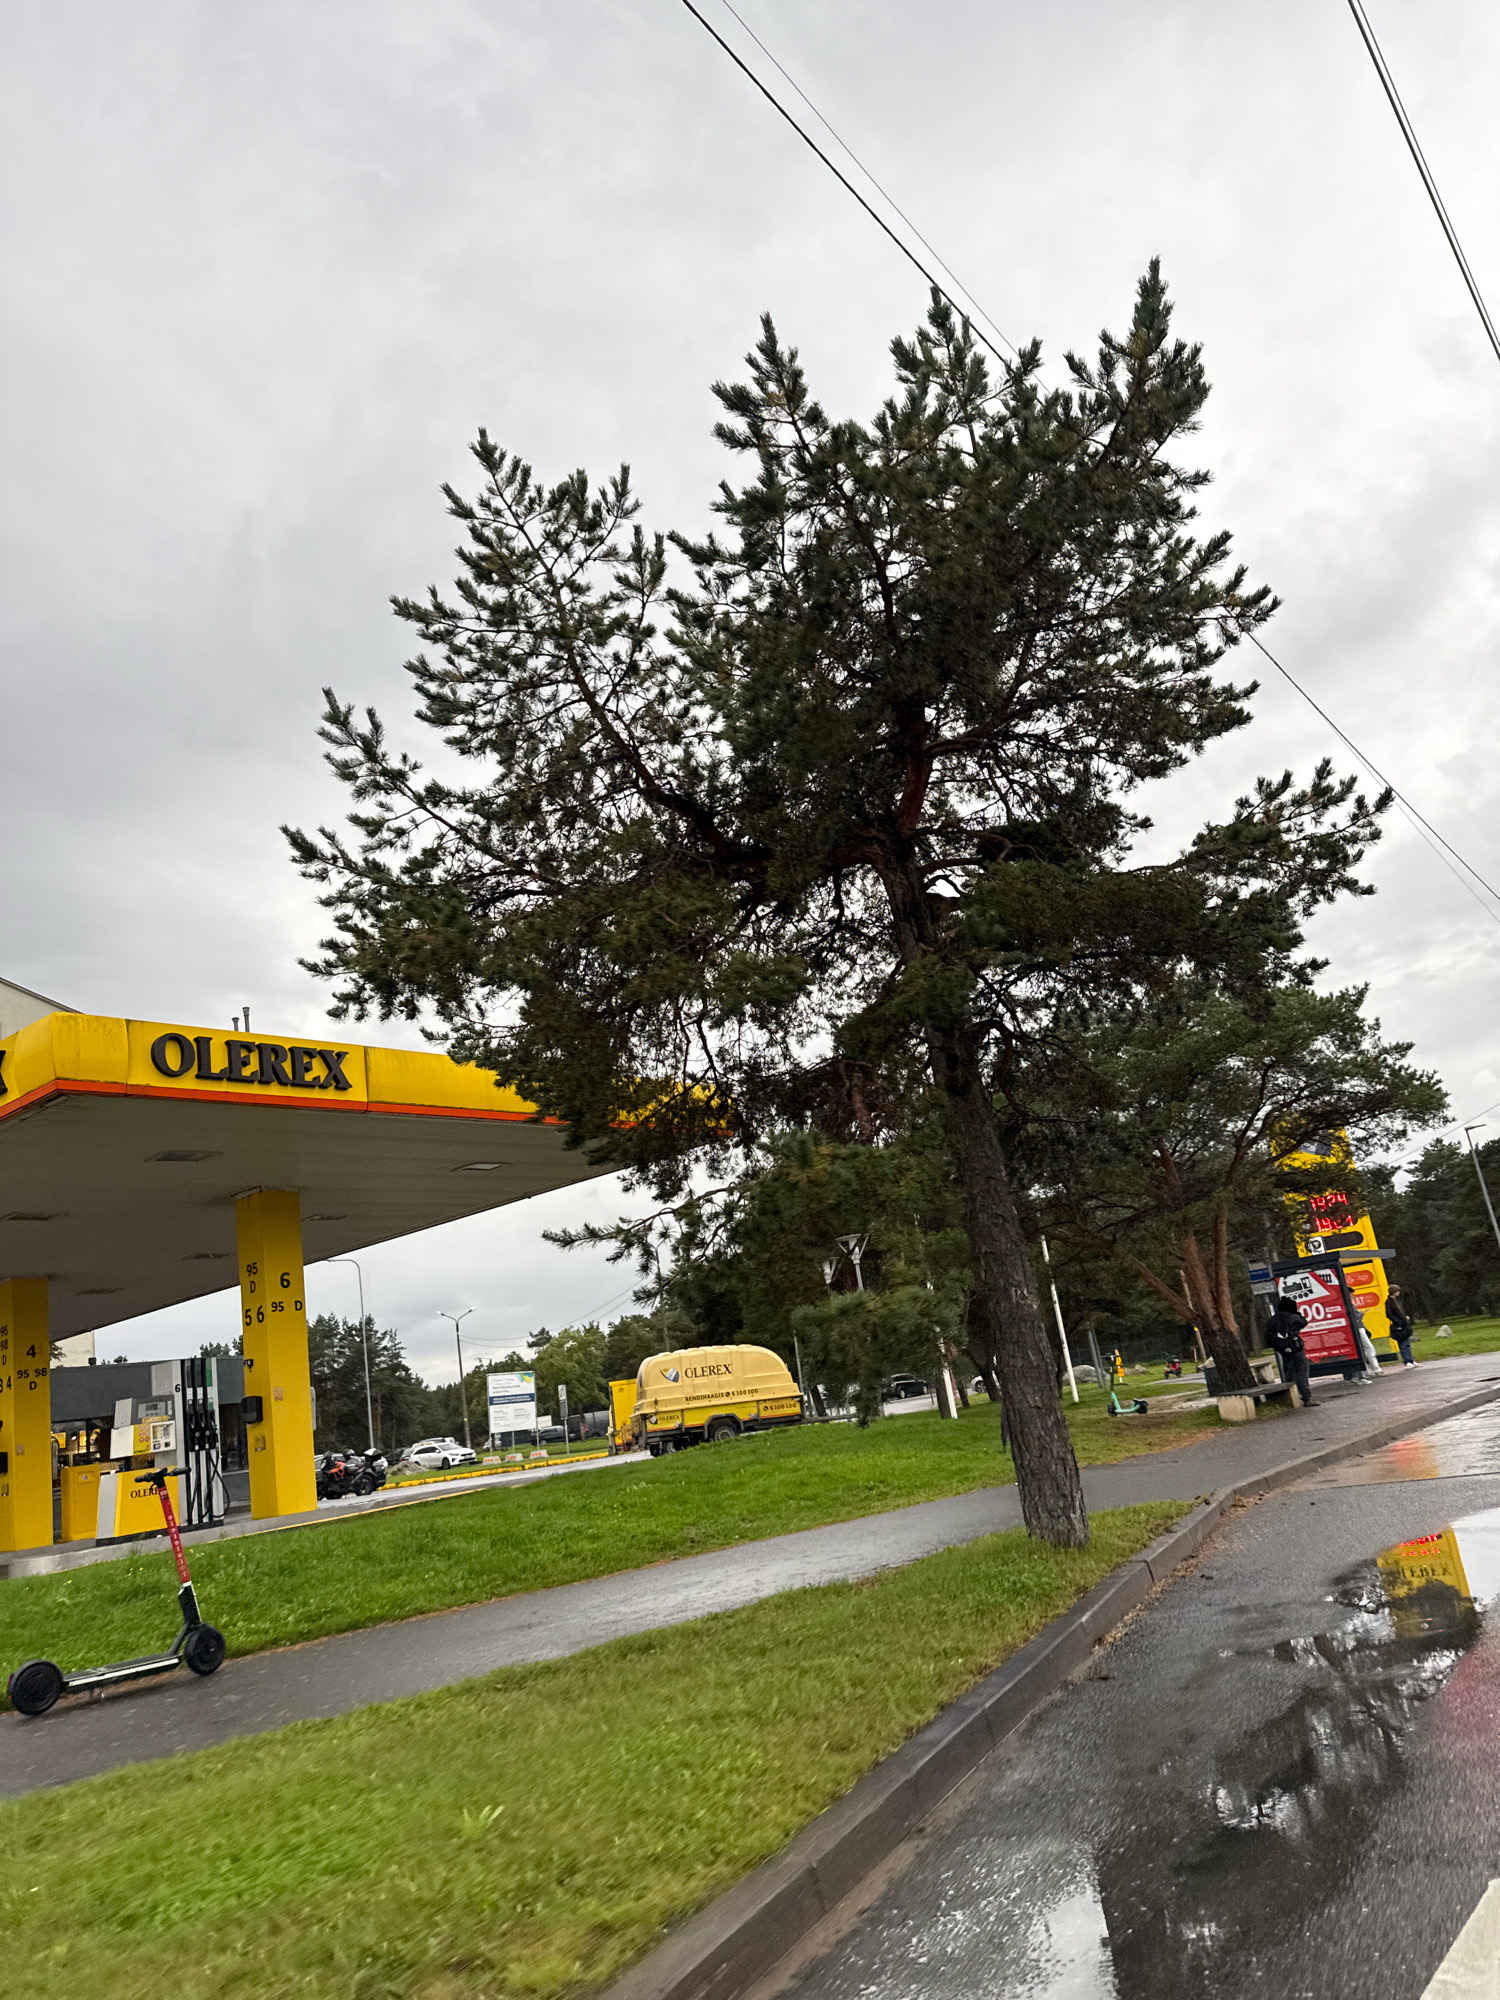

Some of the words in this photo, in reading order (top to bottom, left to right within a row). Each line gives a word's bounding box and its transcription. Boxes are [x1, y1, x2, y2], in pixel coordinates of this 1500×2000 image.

[151, 1032, 353, 1091] OLEREX
[246, 1262, 258, 1277] 95
[249, 1280, 256, 1294] D
[280, 1272, 291, 1289] 6
[271, 1301, 285, 1313] 95
[294, 1300, 303, 1311] D
[244, 1308, 253, 1327] 5
[256, 1305, 265, 1324] 6
[26, 1344, 37, 1358] 4
[2, 1354, 7, 1366] D
[16, 1369, 30, 1379] 95
[34, 1367, 48, 1378] 98
[684, 1363, 732, 1379] OLEREX
[6, 1375, 12, 1390] 4
[29, 1380, 38, 1391] D
[174, 1383, 181, 1393] 6
[685, 1392, 724, 1402] RENDIHAAGIS
[130, 1486, 160, 1499] OLERE
